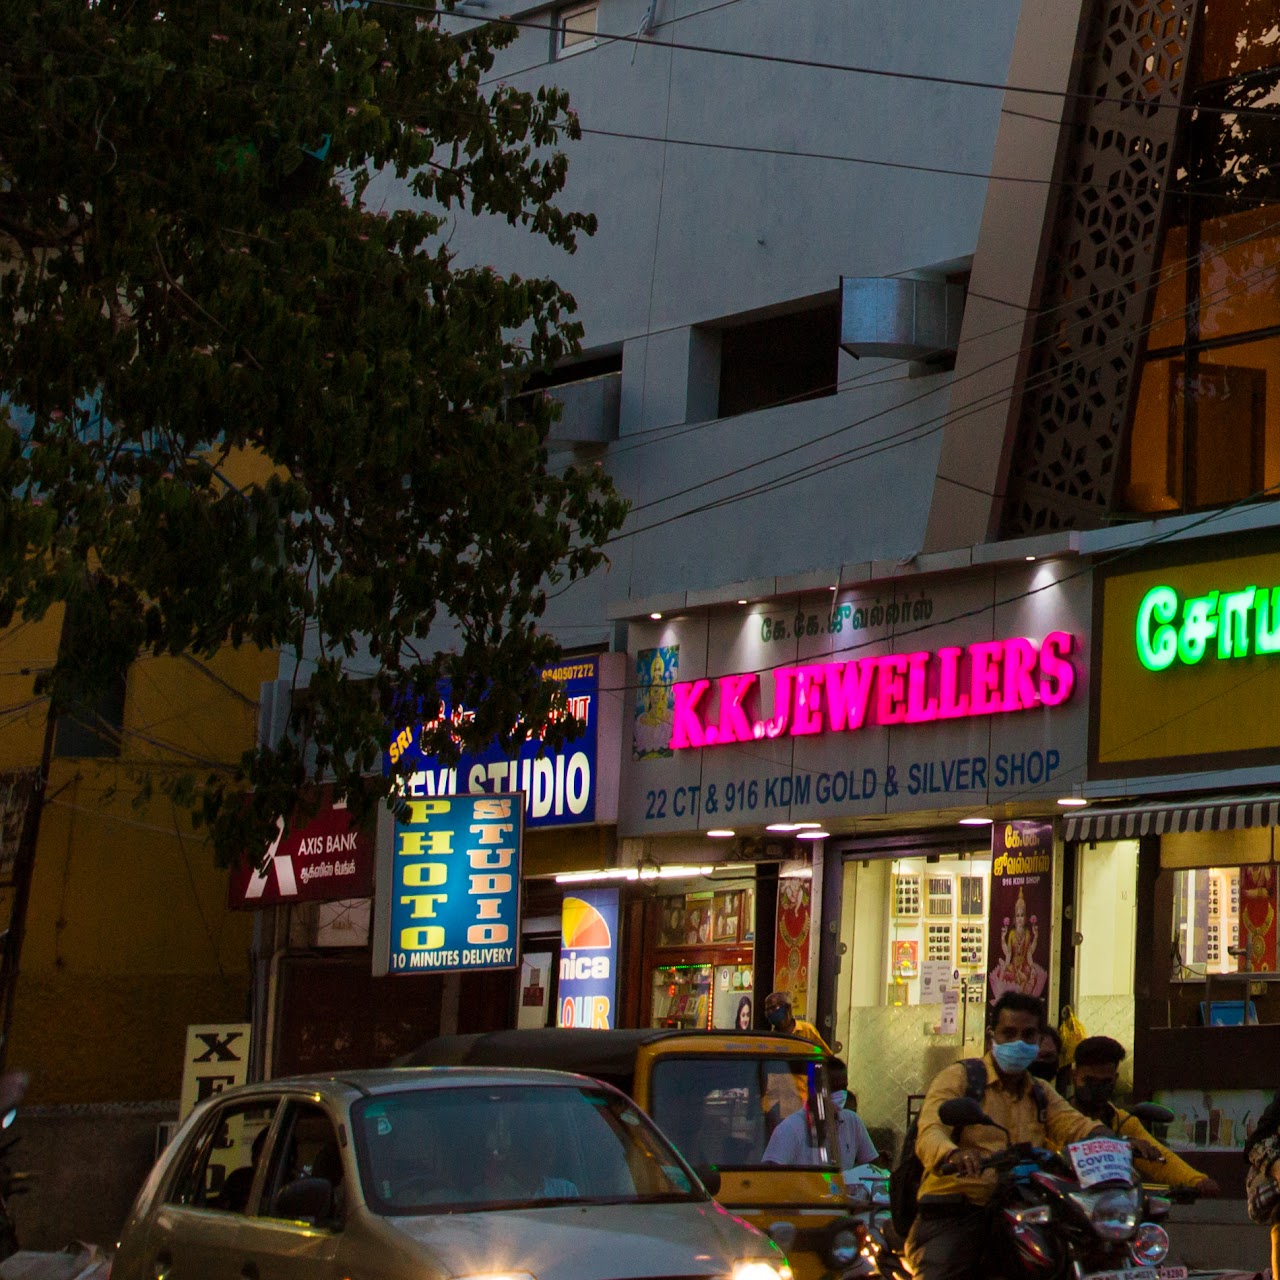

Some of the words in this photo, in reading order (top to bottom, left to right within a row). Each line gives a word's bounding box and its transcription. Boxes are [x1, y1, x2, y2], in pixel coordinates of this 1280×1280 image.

[389, 726, 413, 764] SRI
[645, 792, 668, 819] 22
[672, 786, 700, 817] CT
[704, 783, 719, 813] &
[725, 780, 758, 810] 916
[764, 775, 811, 807] KDM
[815, 767, 877, 804] GOLD
[884, 766, 899, 797] &
[908, 757, 988, 795] SILVER
[994, 750, 1061, 787] SHOP
[298, 836, 324, 856] AXIS
[326, 832, 358, 854] BANK
[398, 800, 454, 950] PHOTO
[466, 799, 515, 945] STUDIO
[393, 952, 406, 969] 10
[410, 950, 460, 968] MINUTES
[462, 947, 513, 966] DELIVERY
[1077, 1154, 1115, 1169] COVID
